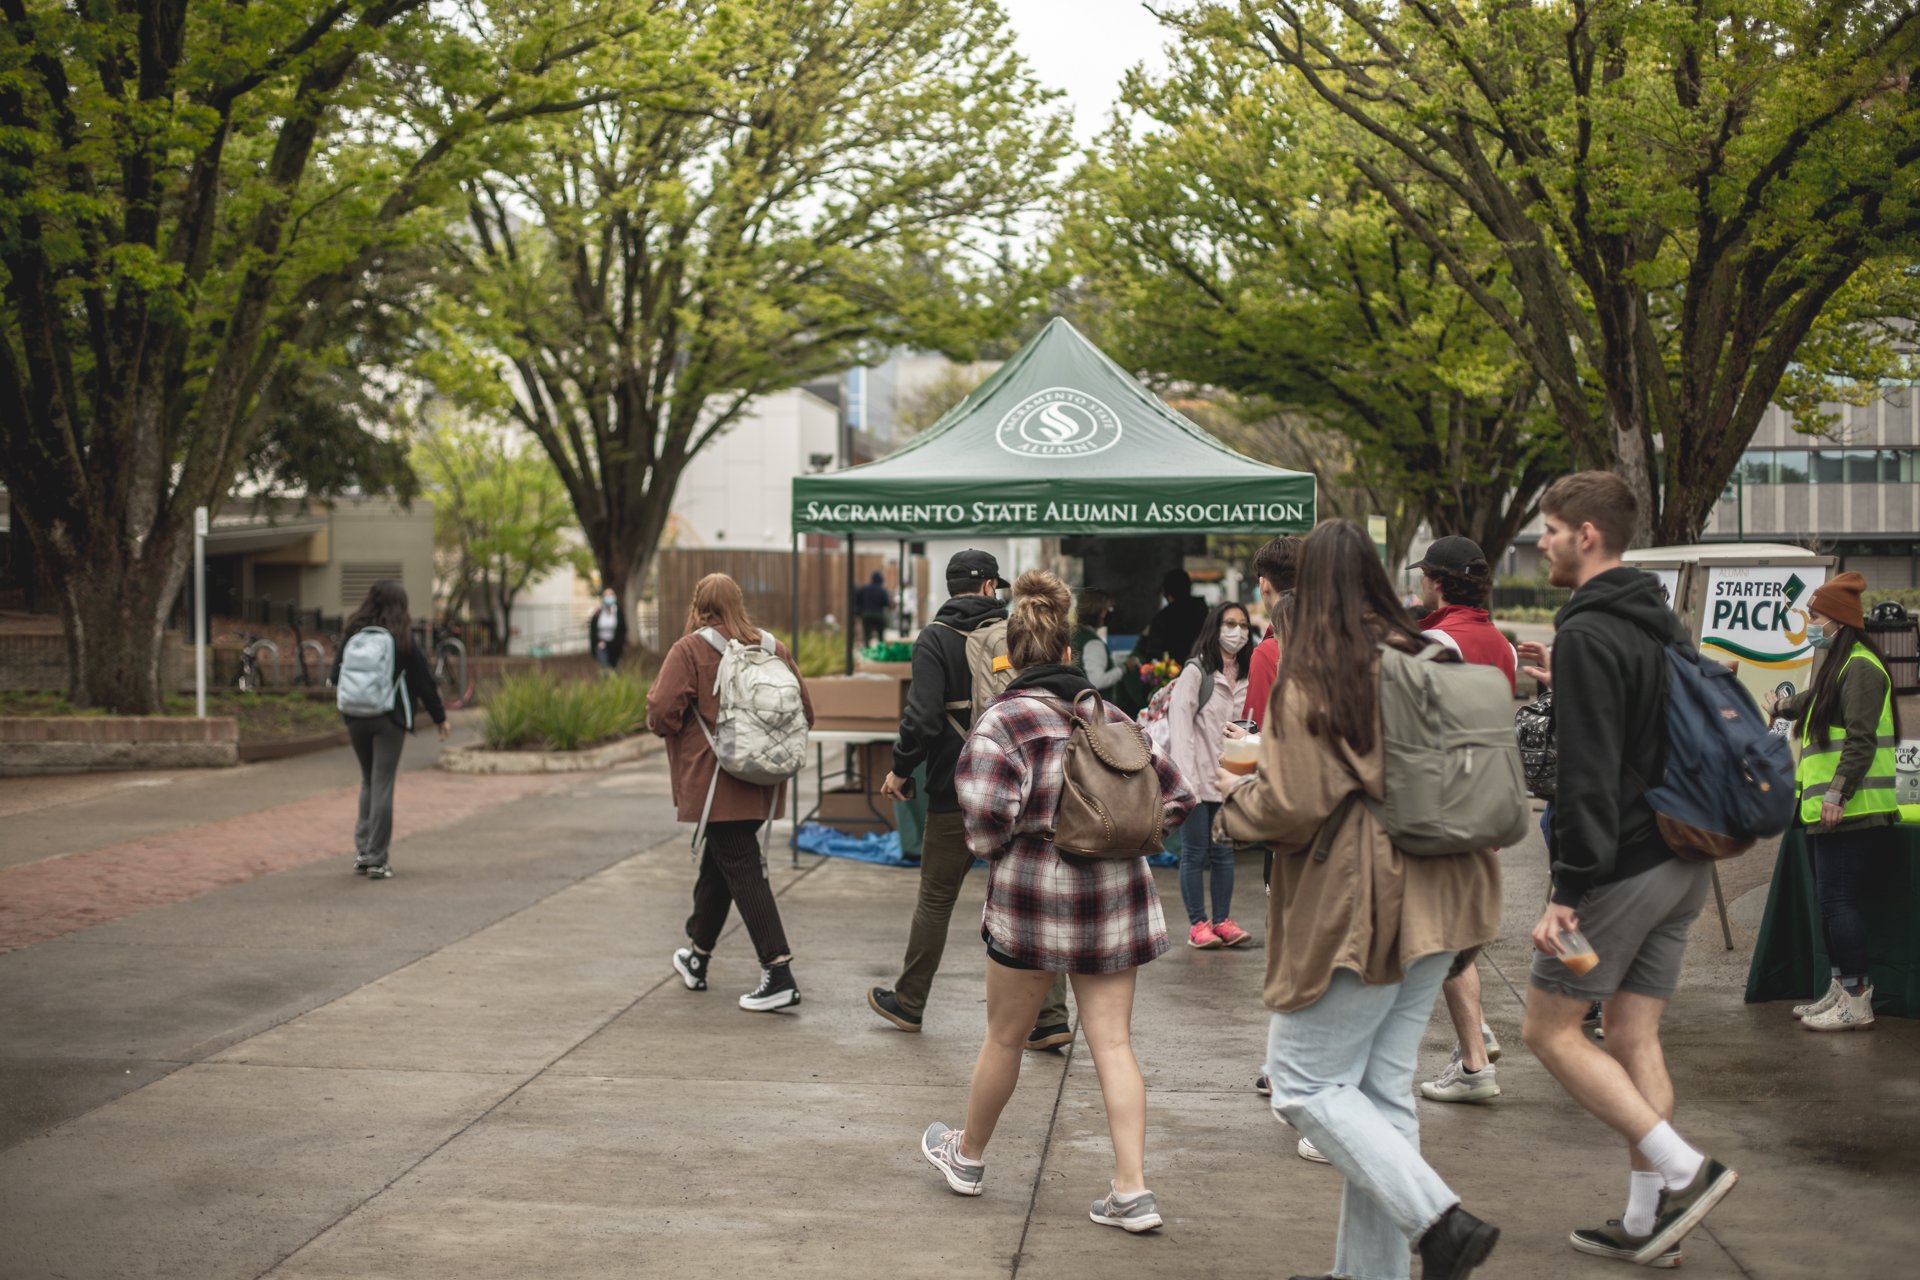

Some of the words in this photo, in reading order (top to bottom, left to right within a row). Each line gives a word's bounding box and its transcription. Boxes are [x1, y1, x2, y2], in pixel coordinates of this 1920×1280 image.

[1004, 392, 1086, 432] SACRAMENTO
[1088, 404, 1115, 429] STATE
[1018, 441, 1098, 453] ALUMNI
[805, 501, 965, 522] SACRAMENTO
[971, 501, 1038, 522] STATE
[1043, 501, 1138, 522] ALUMNI
[1144, 501, 1304, 522] ASSOCIATION
[1715, 581, 1783, 597] STARTER
[1712, 599, 1792, 631] PACK
